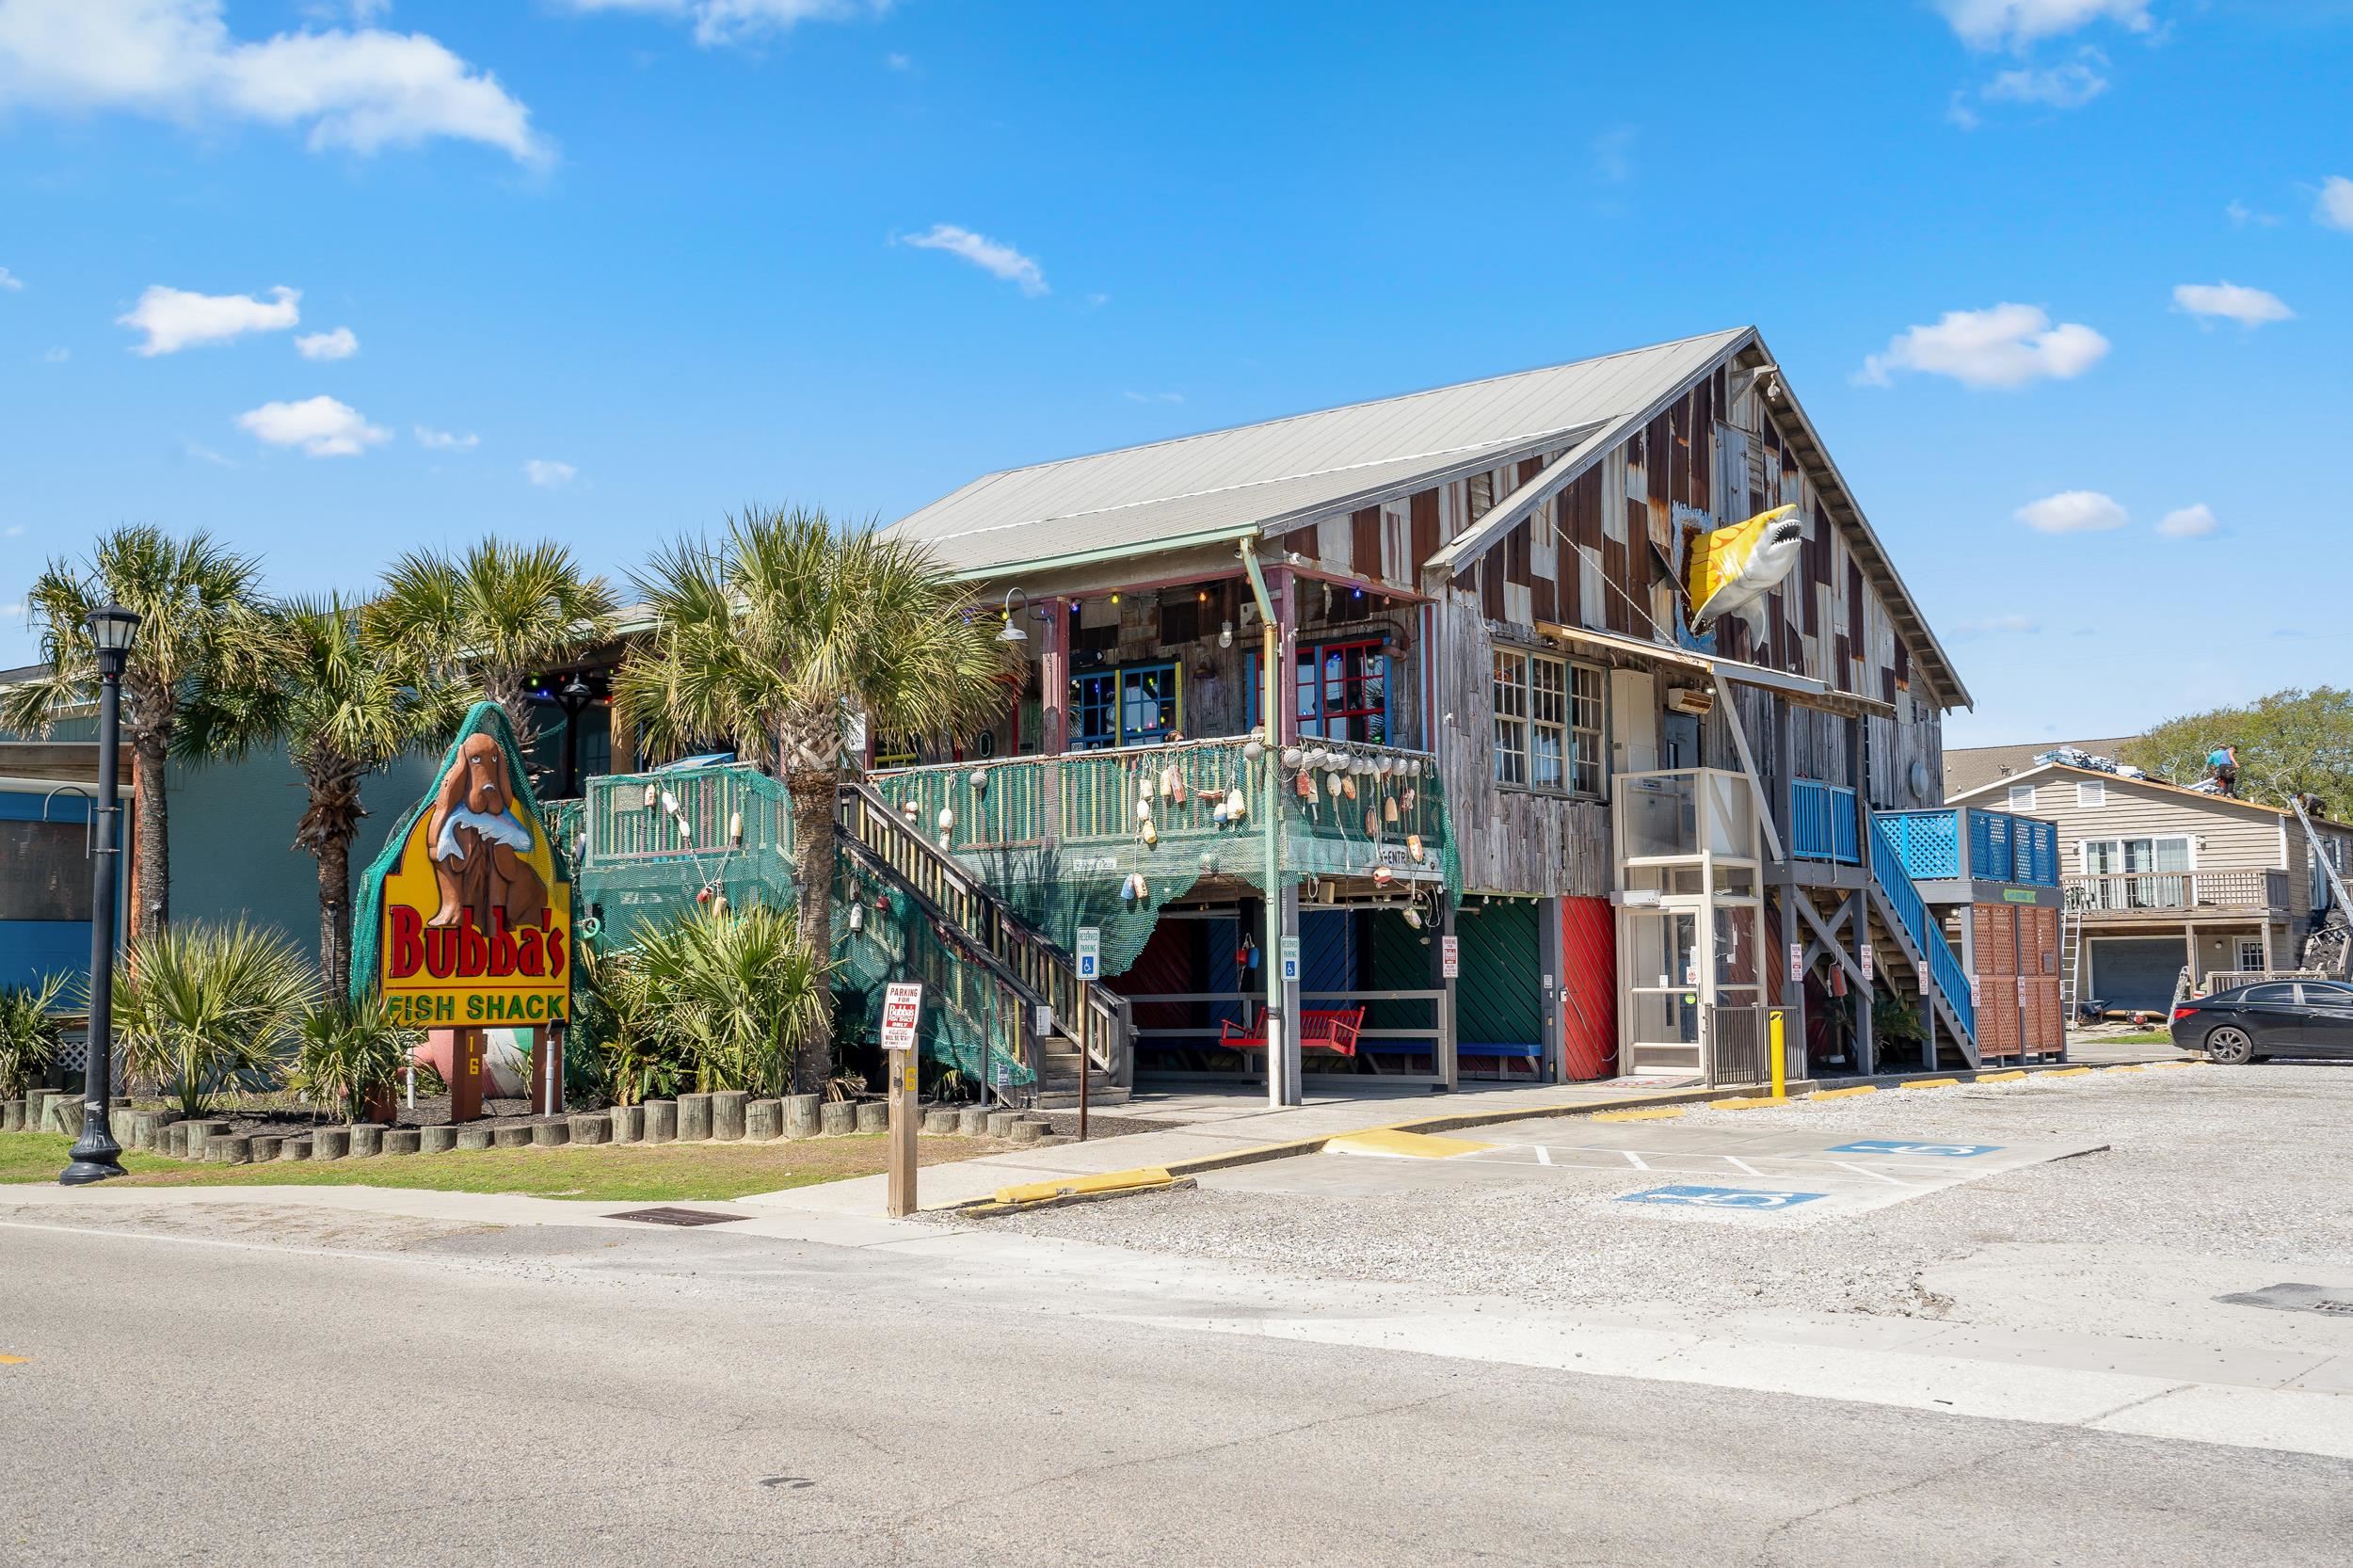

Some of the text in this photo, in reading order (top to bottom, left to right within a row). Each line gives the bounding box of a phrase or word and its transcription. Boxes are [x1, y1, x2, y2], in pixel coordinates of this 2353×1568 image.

[389, 904, 565, 979] Bubba's
[1080, 944, 1096, 952] PARKING
[890, 988, 919, 997] PARKING
[388, 994, 565, 1021] FISH SHACK
